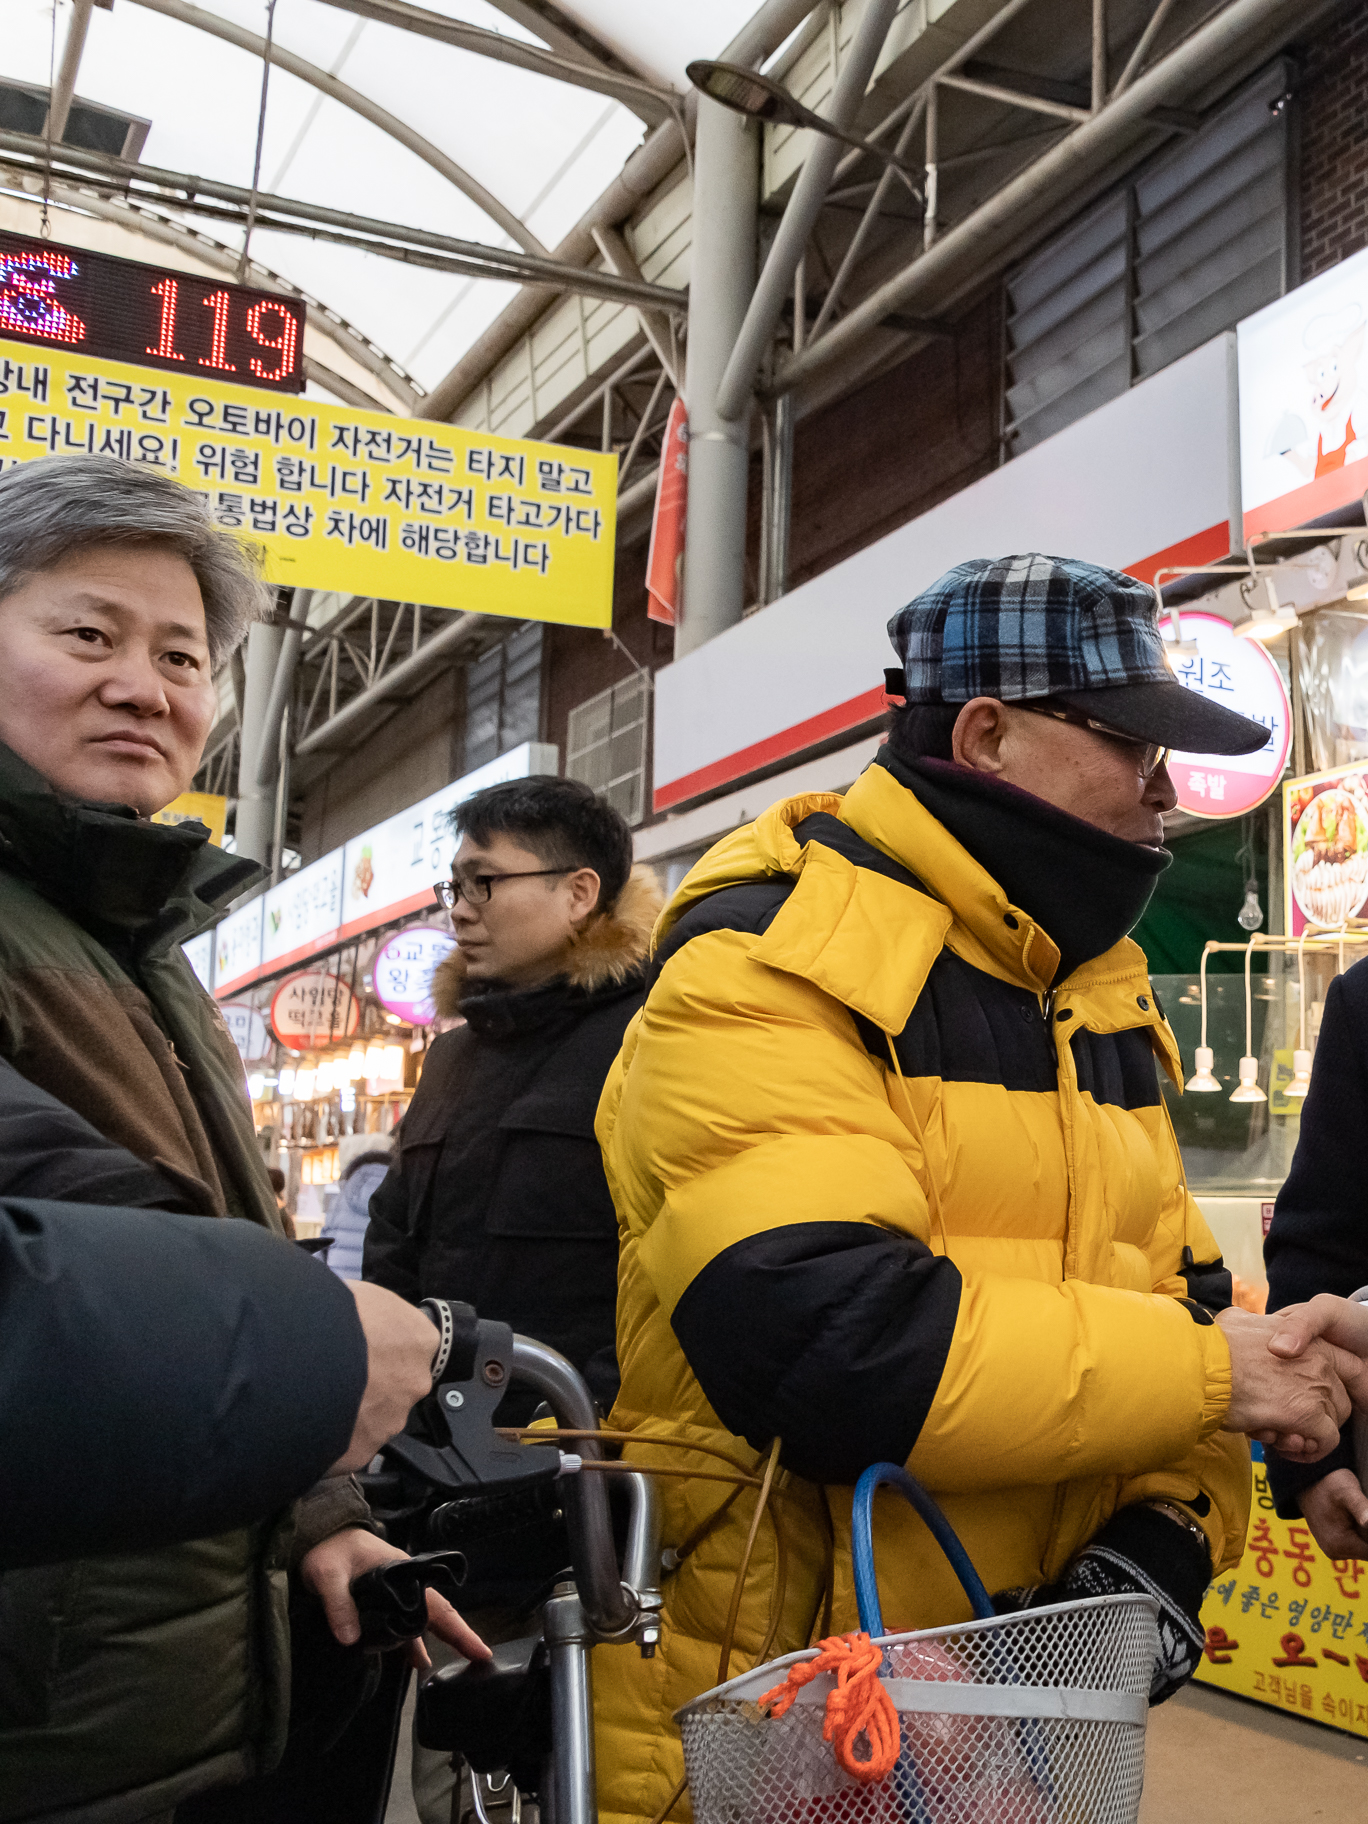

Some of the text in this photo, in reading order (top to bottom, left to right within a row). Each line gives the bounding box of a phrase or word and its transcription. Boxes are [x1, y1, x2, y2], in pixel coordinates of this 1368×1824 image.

[146, 279, 297, 381] 119
[66, 374, 171, 422] 전구간
[184, 398, 316, 450] 오토바이
[331, 425, 453, 472] 자전거는
[468, 450, 524, 486] 타지
[539, 461, 592, 495] 말고
[27, 416, 178, 471] 다니세요!
[197, 444, 259, 485] 위험
[276, 455, 370, 502] 합니다
[384, 478, 473, 519] 자전거
[489, 495, 601, 540] 타고가다
[201, 491, 549, 574] 통법상 차에 해당합니다
[1188, 770, 1227, 800] 족발
[1245, 1517, 1315, 1588] 충동
[1241, 1585, 1280, 1619] 좋은
[1288, 1598, 1353, 1640] 영양만
[1253, 1669, 1313, 1711] 고객님을
